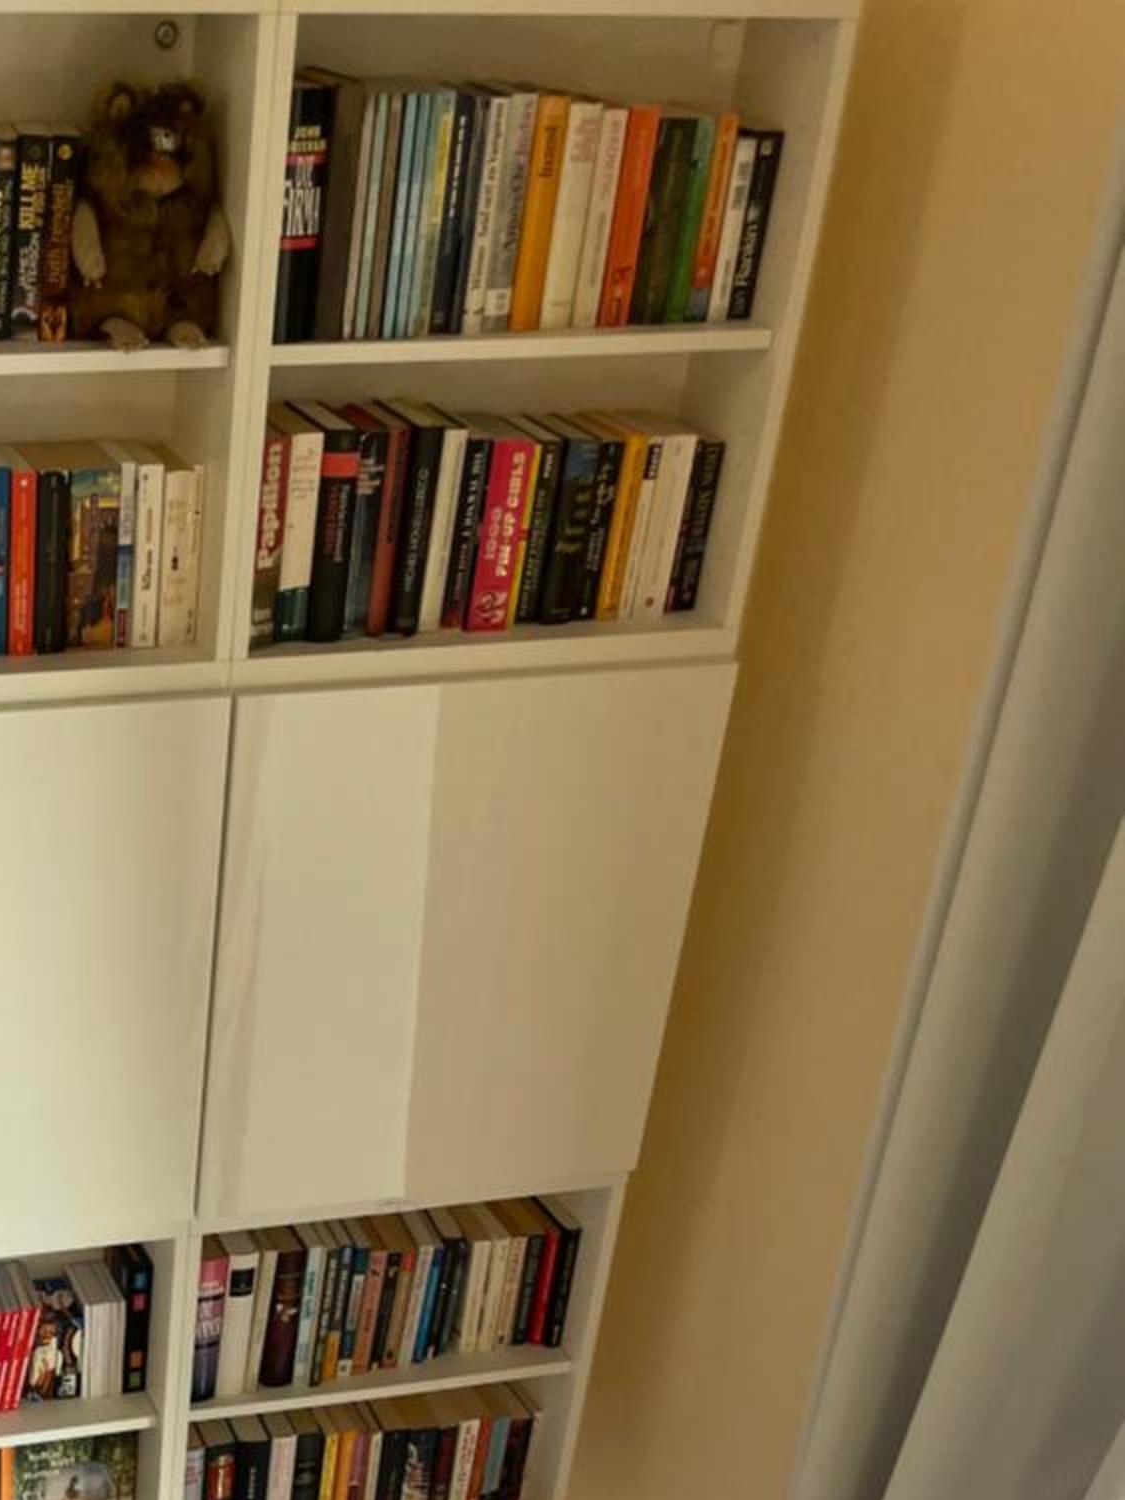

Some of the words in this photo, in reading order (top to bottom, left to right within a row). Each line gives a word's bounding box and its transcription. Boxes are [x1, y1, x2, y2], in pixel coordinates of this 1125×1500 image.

[734, 223, 758, 287] Rankin
[258, 442, 284, 571] Papillon
[506, 451, 526, 509] GIRLS
[483, 507, 503, 560] 1000
